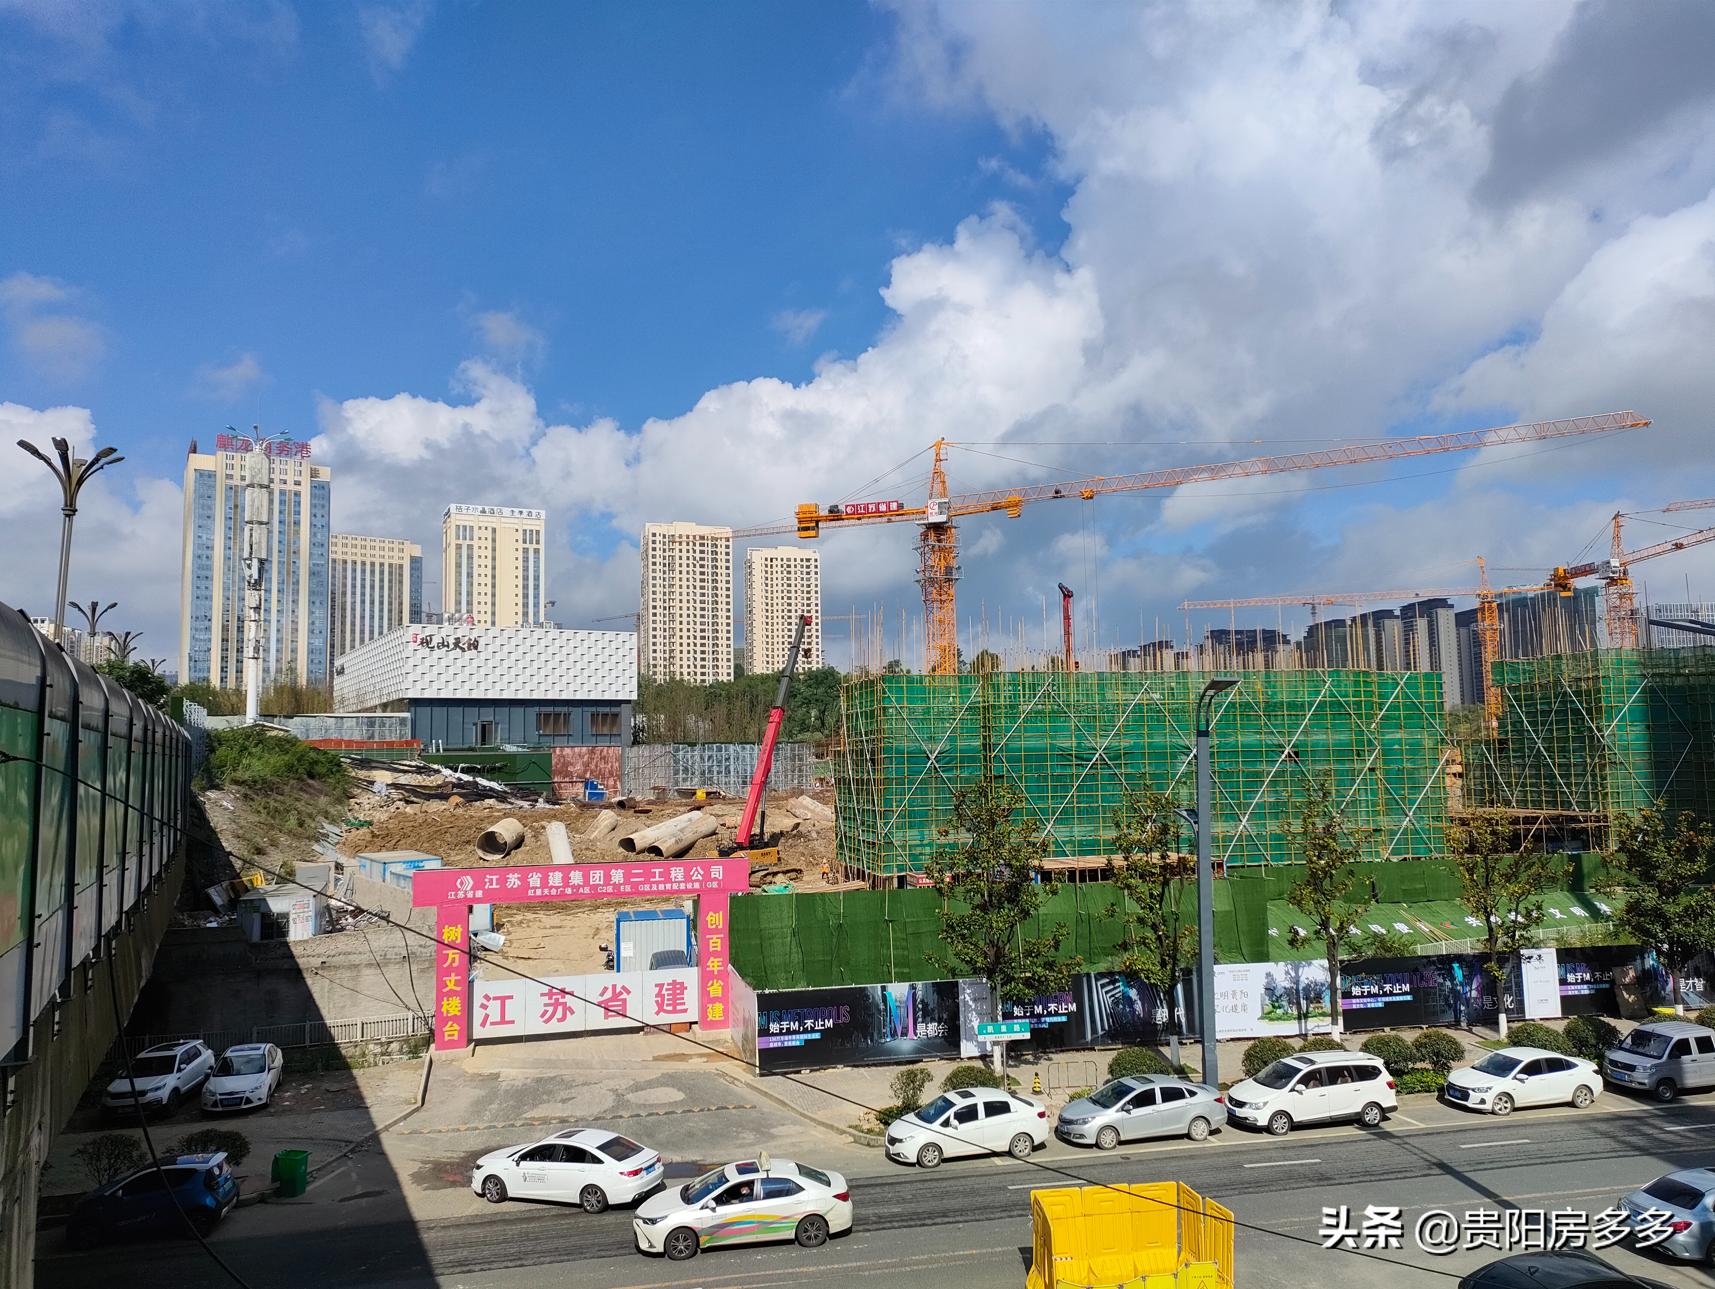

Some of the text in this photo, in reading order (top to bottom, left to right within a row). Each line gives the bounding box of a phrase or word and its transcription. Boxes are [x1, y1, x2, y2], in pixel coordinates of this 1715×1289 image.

[447, 889, 484, 899] 江苏省建
[484, 865, 724, 889] 江苏省建集团第二工程公司
[441, 924, 462, 1041] 树万丈楼台
[706, 911, 726, 1021] 创百年省建
[479, 979, 689, 1029] 江苏省建
